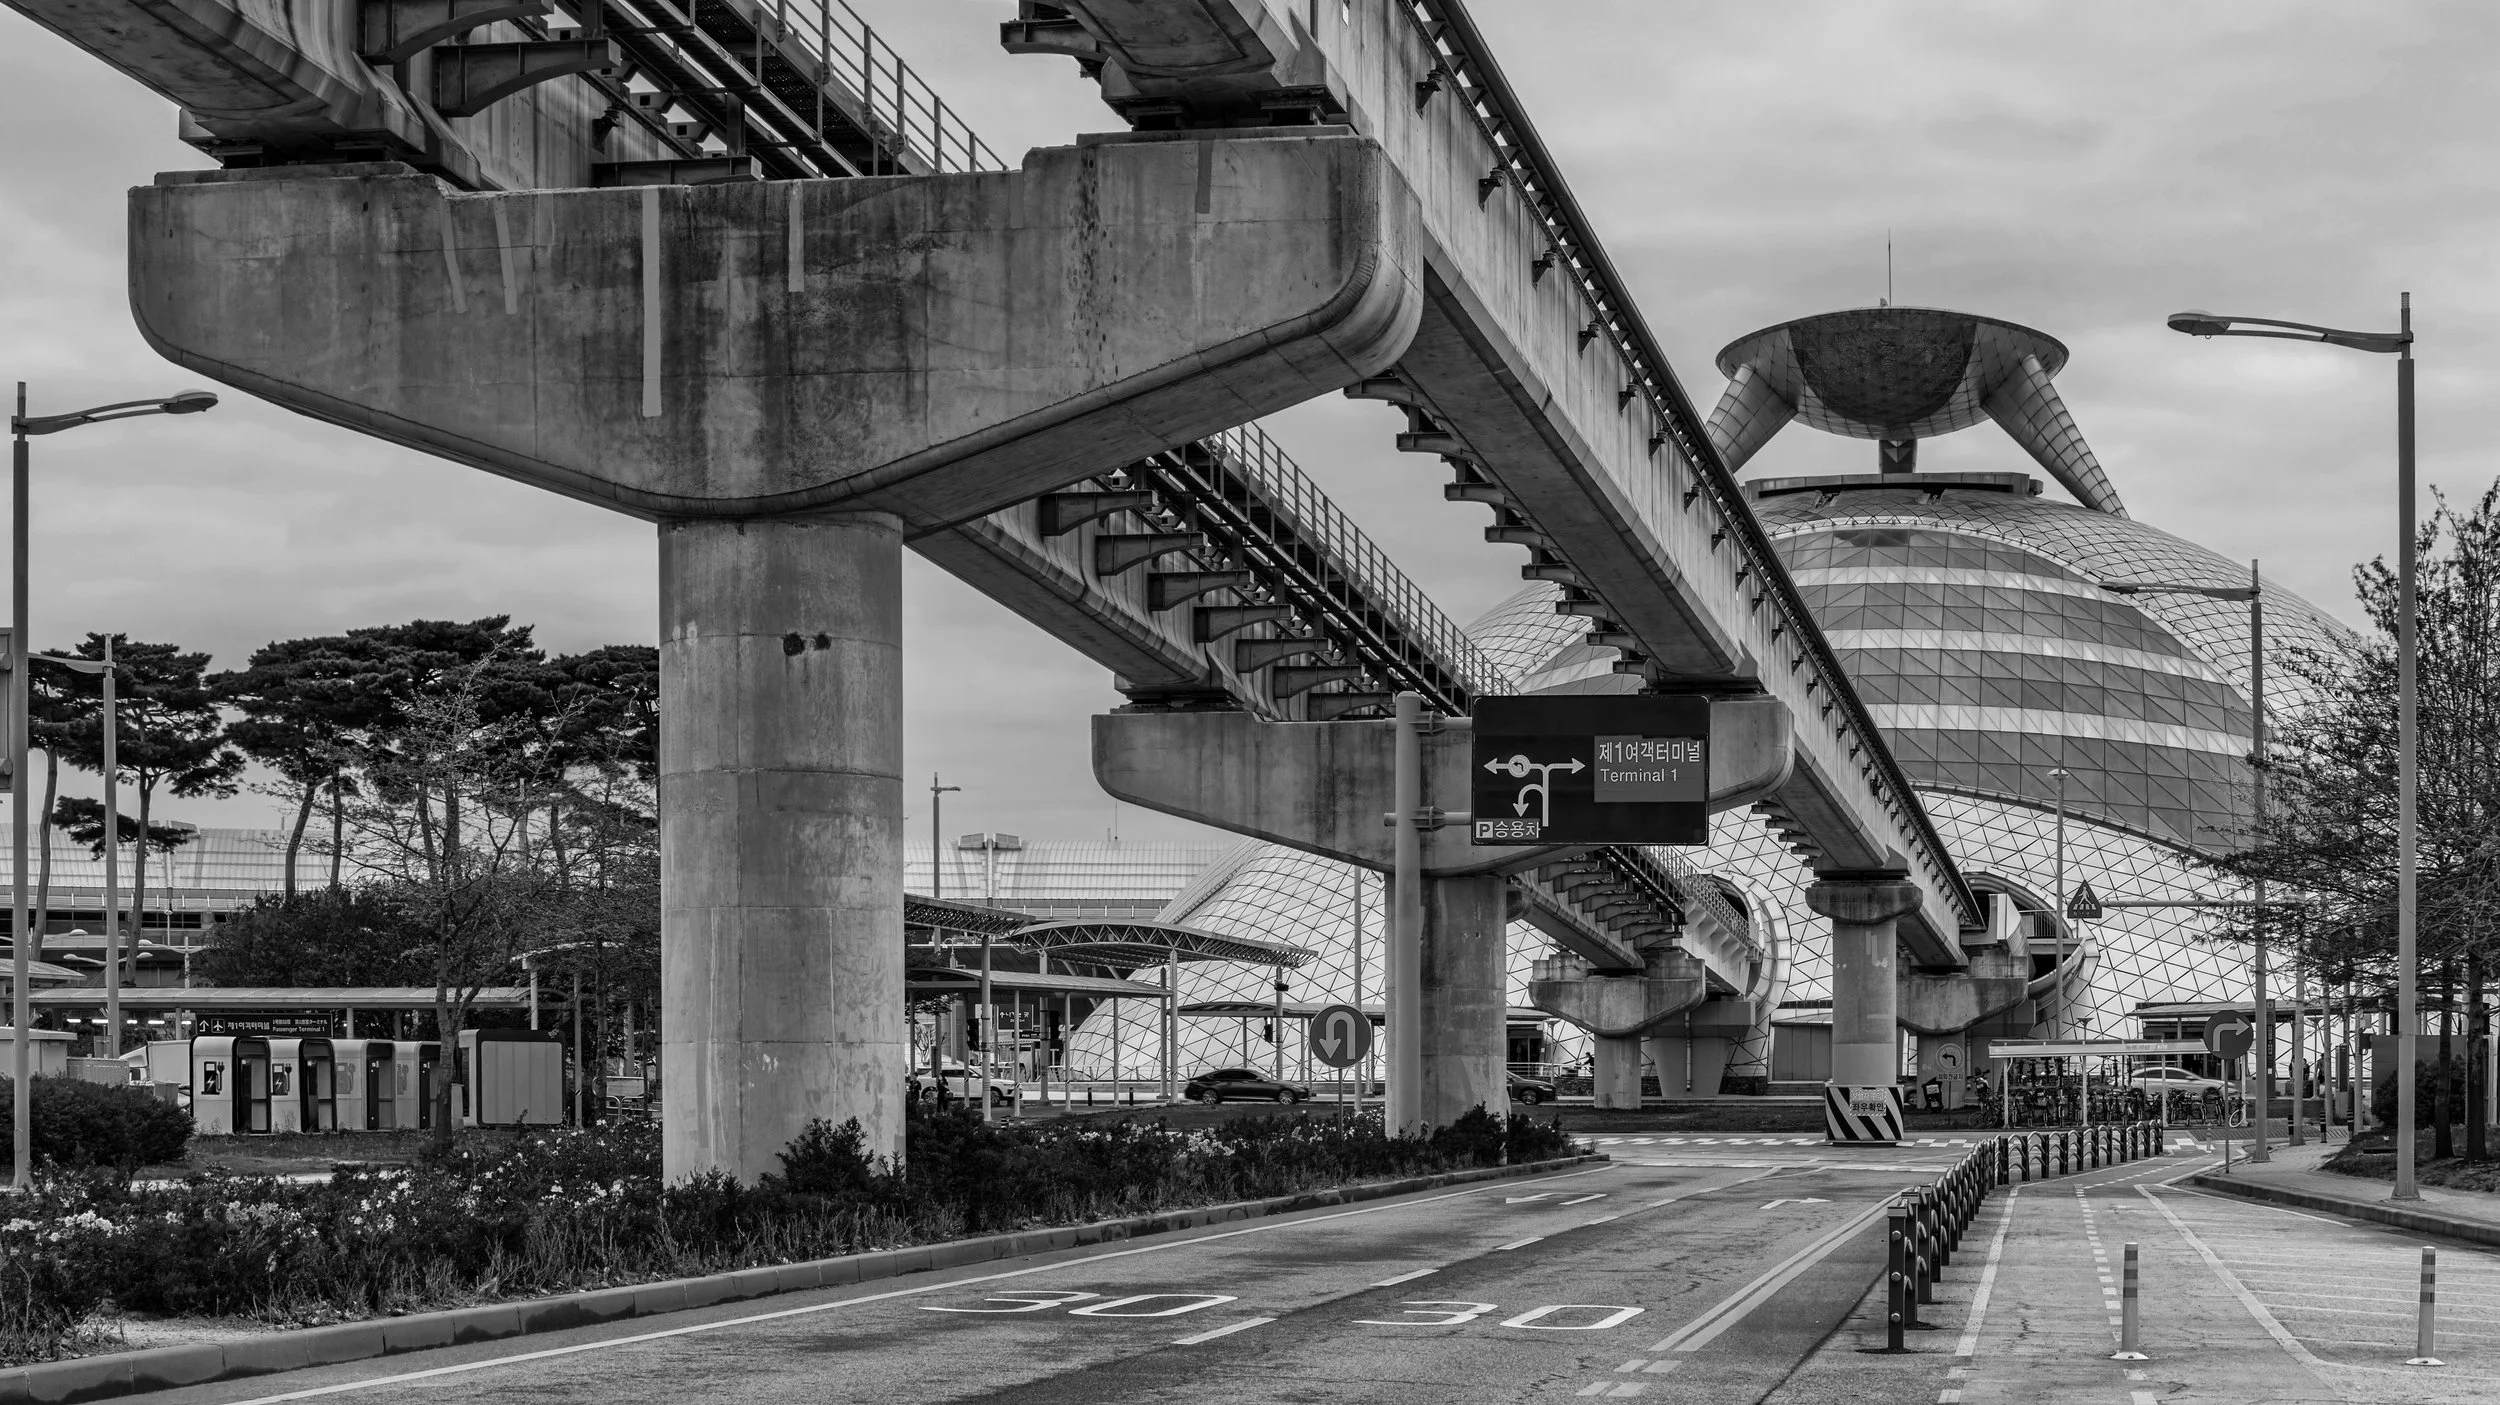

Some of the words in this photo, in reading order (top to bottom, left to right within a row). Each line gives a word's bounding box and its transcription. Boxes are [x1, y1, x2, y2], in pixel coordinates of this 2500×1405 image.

[1598, 740, 1700, 764] 제1여객터미널
[1600, 768, 1665, 782] Terminal
[1670, 768, 1677, 782] 1
[1494, 821, 1541, 839] 승용차
[1852, 1102, 1884, 1112] 좌우확인
[918, 1290, 1239, 1317] 30
[1351, 1301, 1645, 1330] 30
